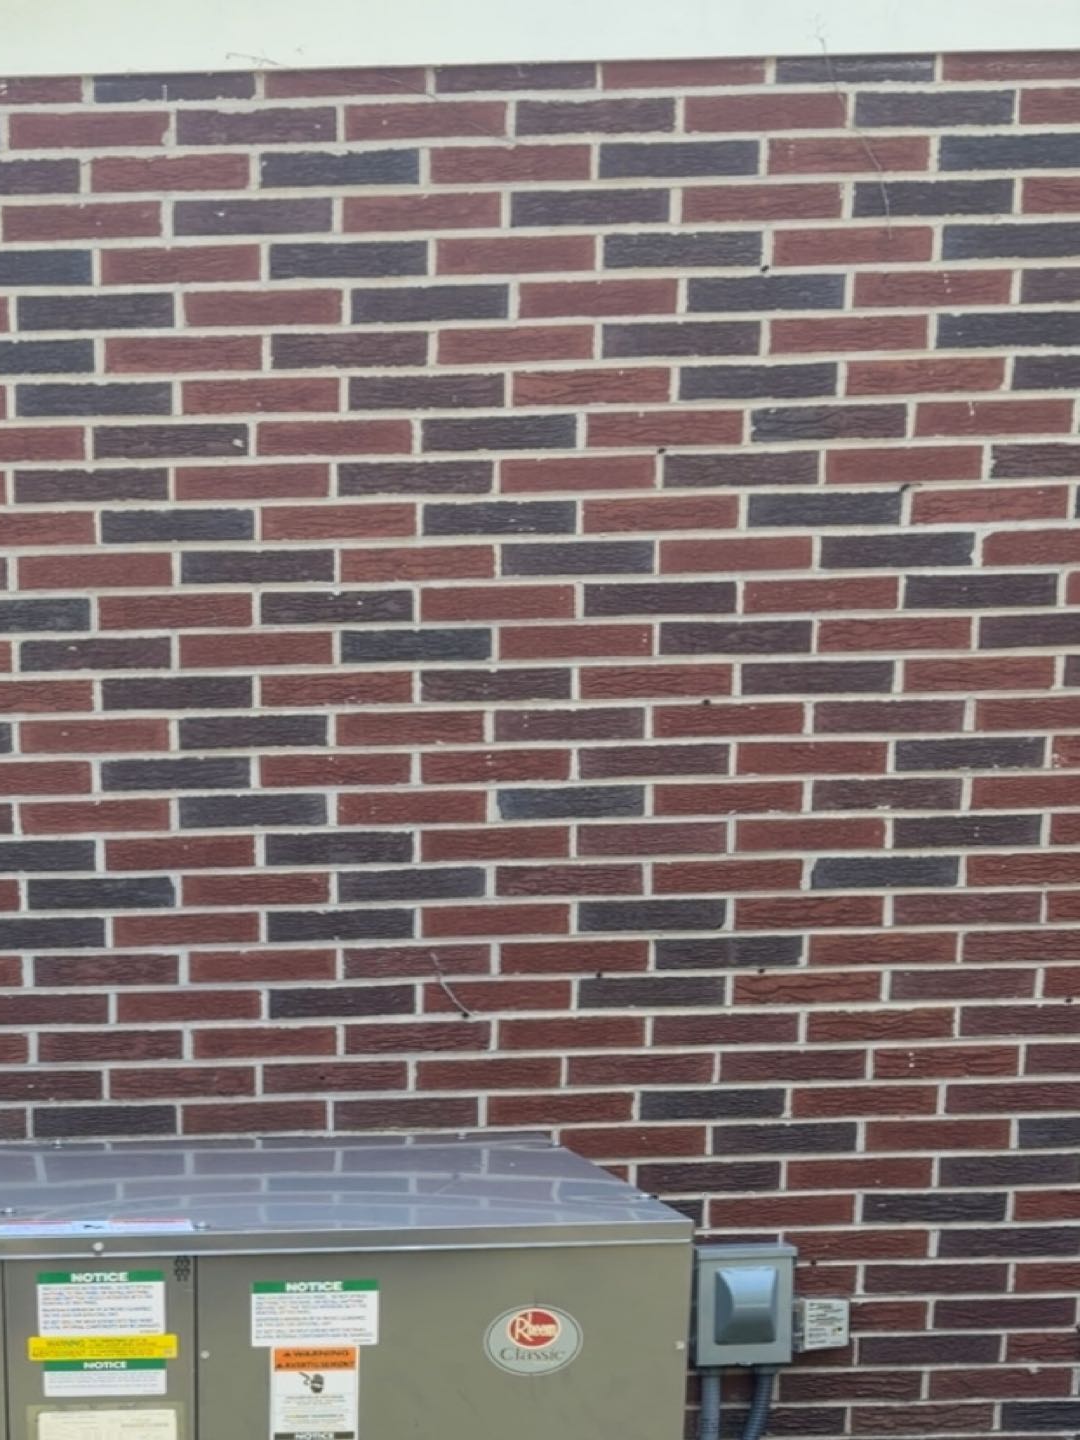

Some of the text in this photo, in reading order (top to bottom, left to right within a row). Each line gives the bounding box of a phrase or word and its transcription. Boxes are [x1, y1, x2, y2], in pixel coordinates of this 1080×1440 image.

[71, 1272, 129, 1283] NOTICE
[285, 1281, 343, 1292] NOTICE
[515, 1311, 557, 1342] Rheem
[500, 1347, 566, 1361] Classic
[83, 1361, 128, 1370] NOTICE
[295, 1432, 334, 1440] NOTICE
